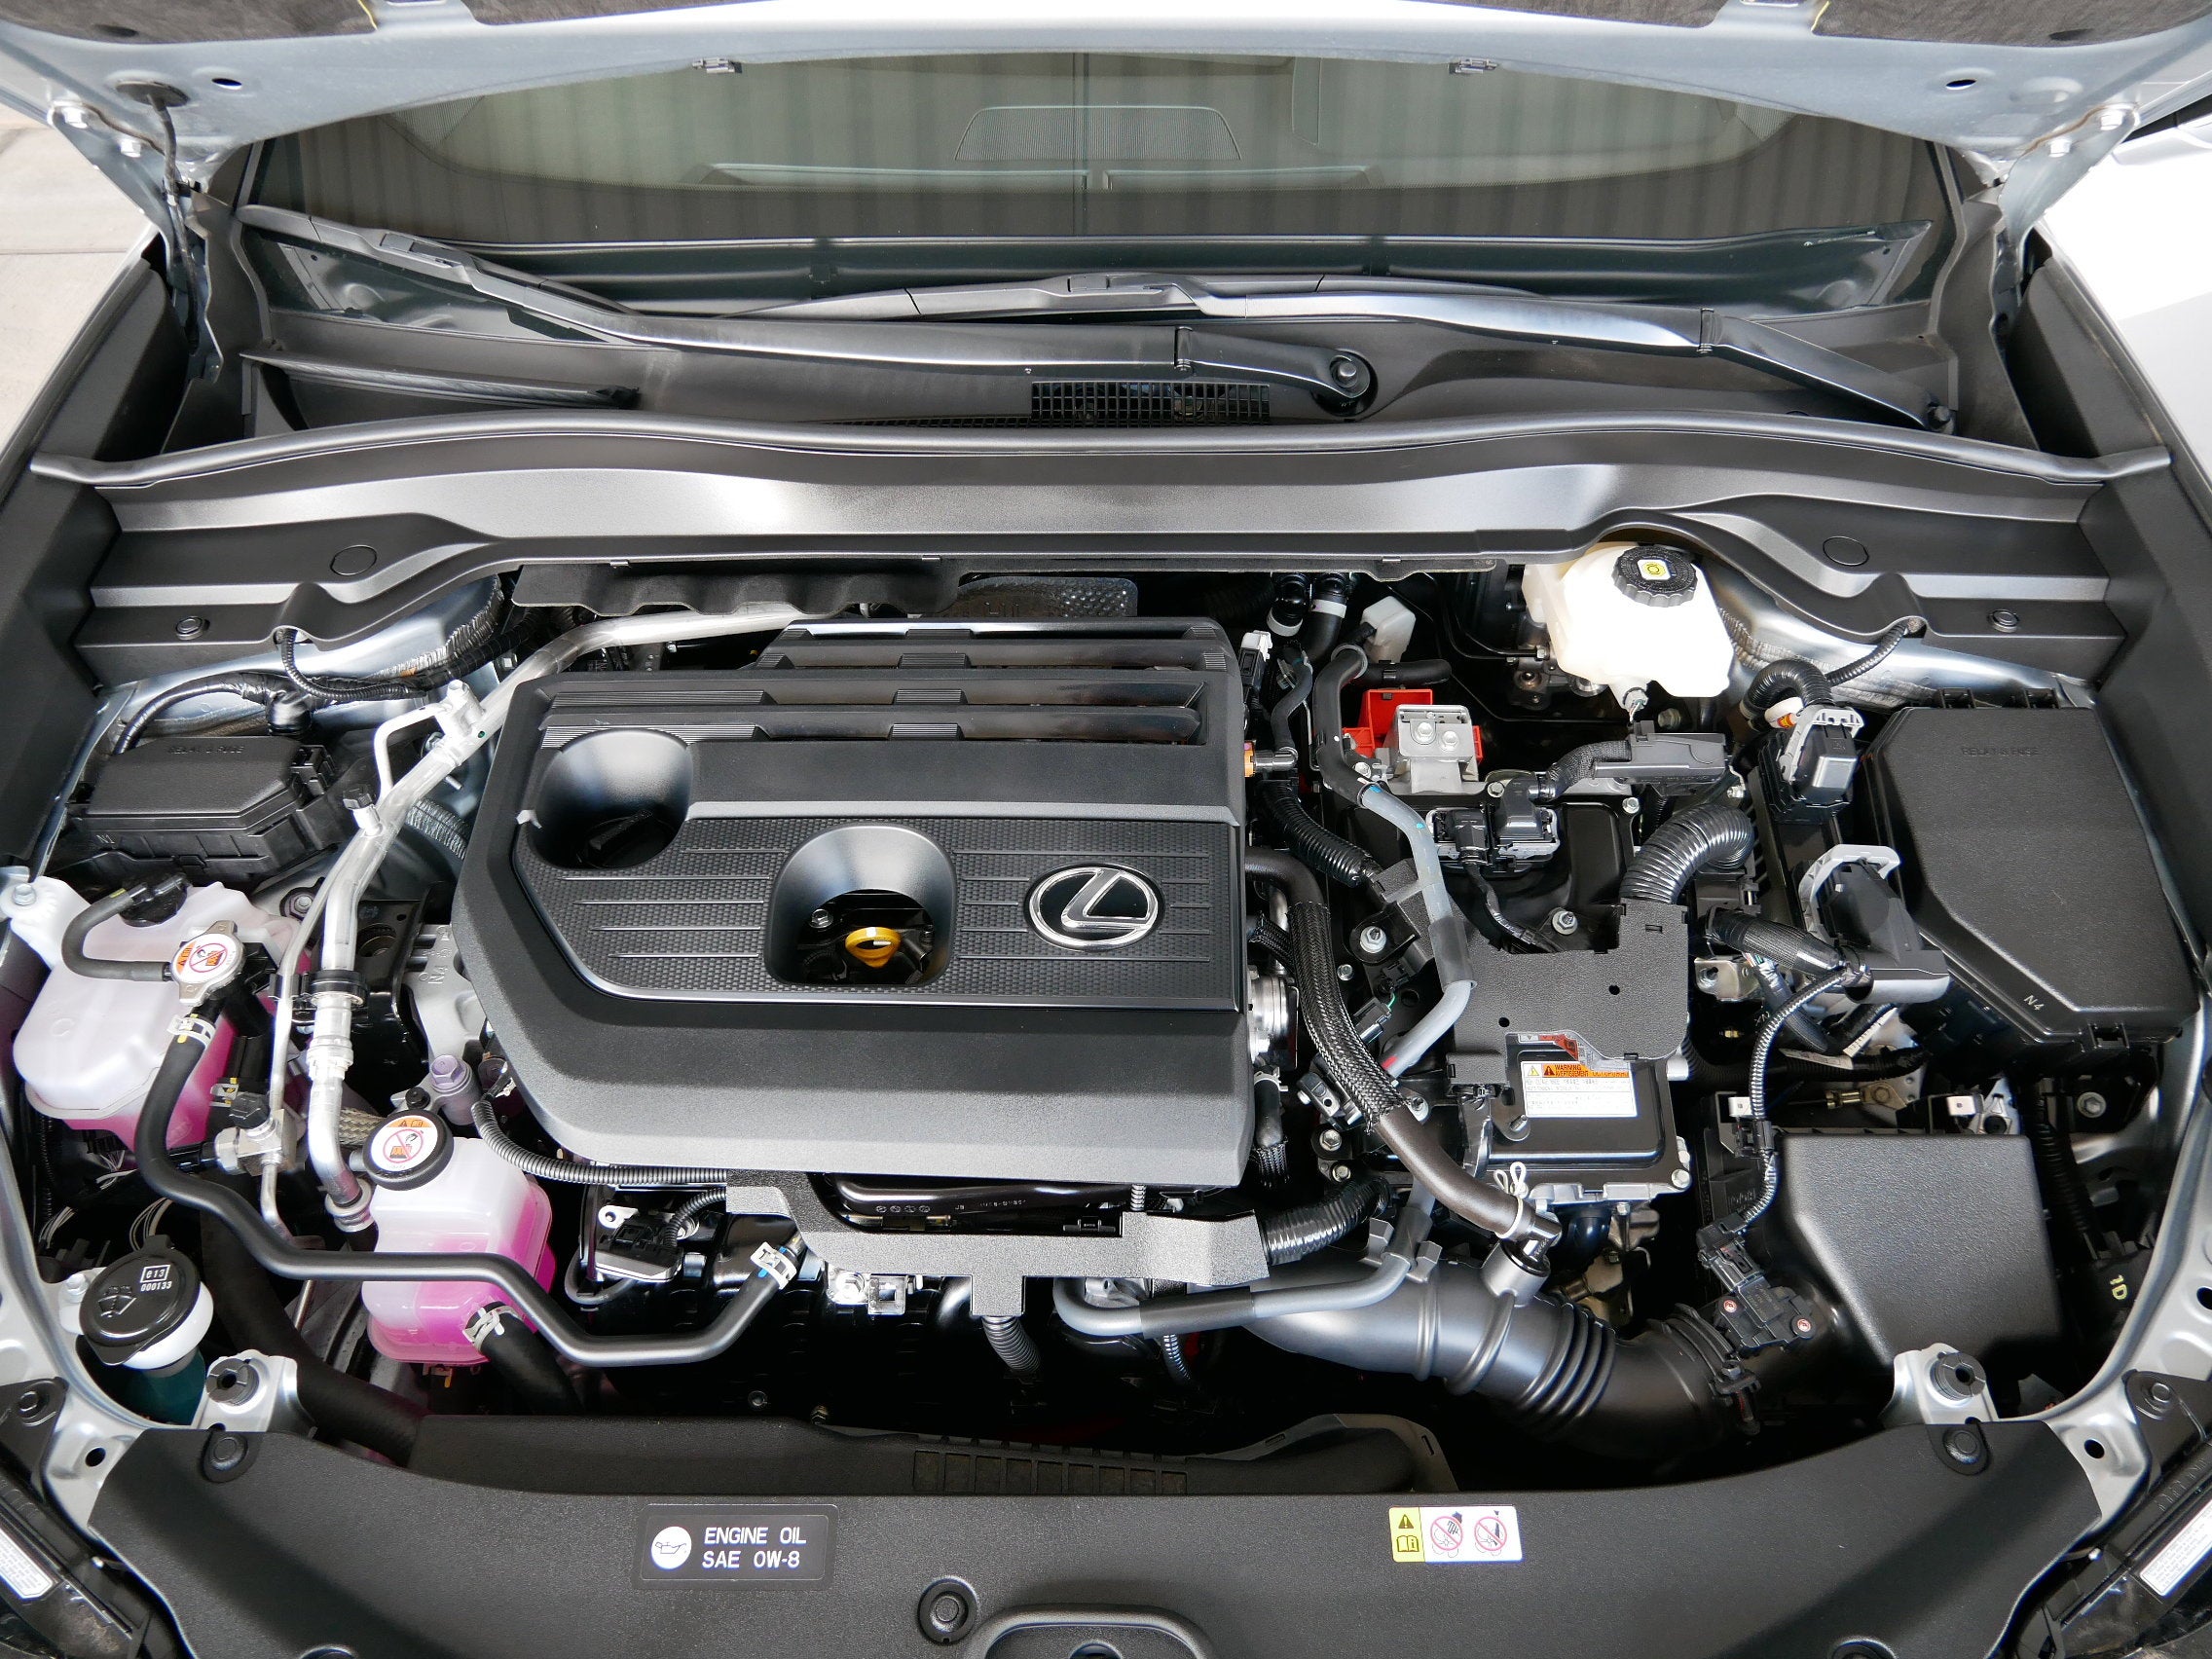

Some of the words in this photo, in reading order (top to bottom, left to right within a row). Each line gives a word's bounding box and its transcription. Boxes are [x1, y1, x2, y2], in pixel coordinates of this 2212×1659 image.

[146, 1269, 166, 1279] e13
[140, 1280, 172, 1292] 000133
[703, 1527, 769, 1545] ENGINE
[779, 1527, 807, 1545] OIL
[701, 1550, 742, 1569] SAE
